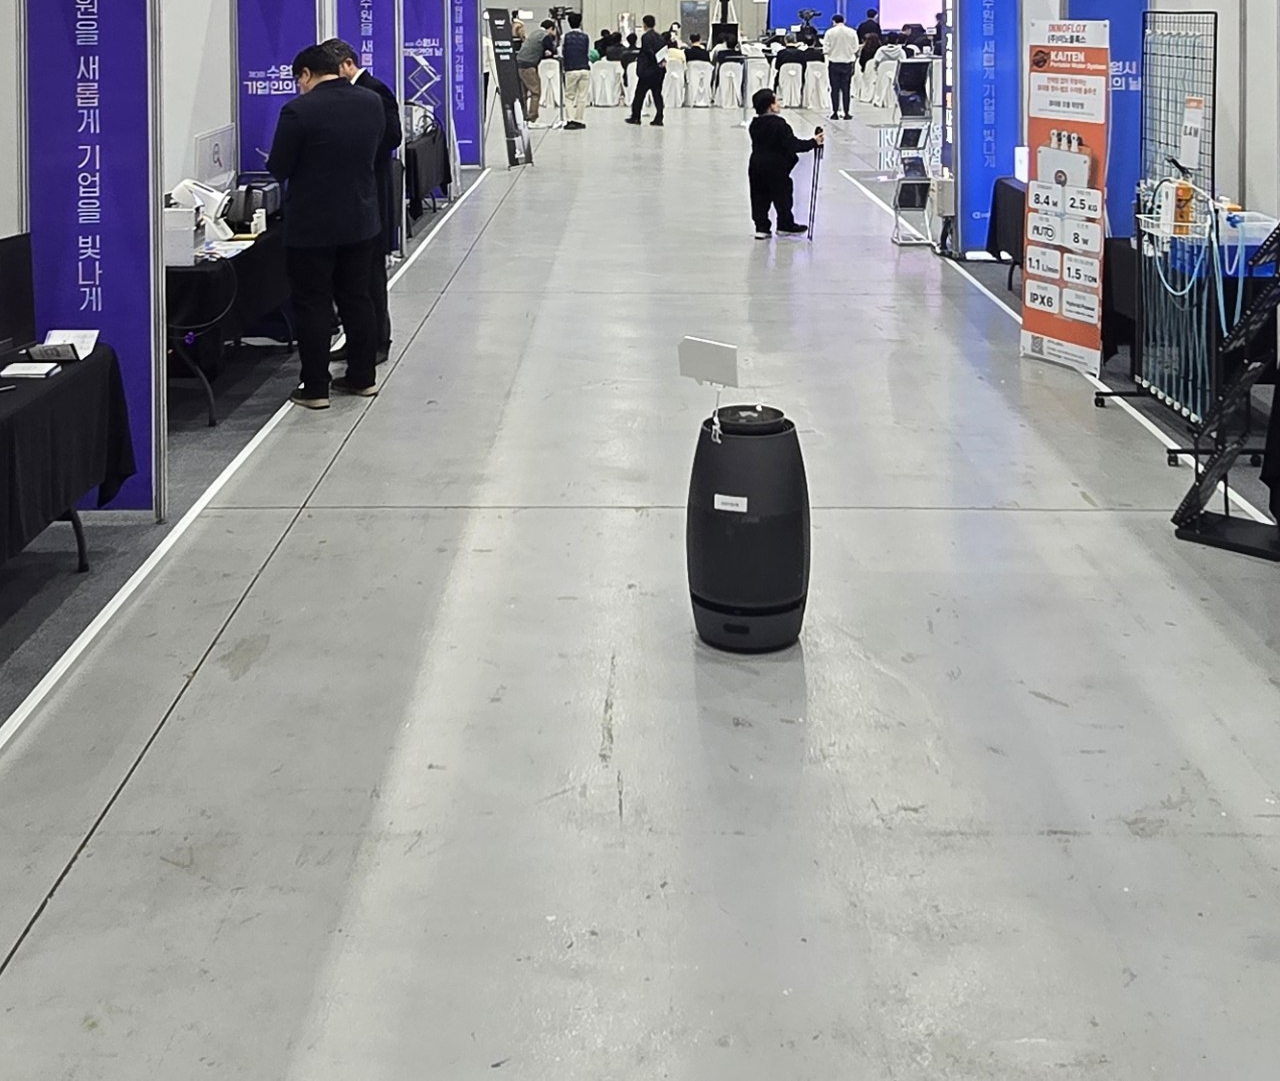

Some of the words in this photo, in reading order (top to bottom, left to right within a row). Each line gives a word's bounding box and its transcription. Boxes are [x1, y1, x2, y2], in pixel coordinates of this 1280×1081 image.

[1050, 51, 1086, 62] KAITEN
[76, 56, 101, 135] 새롭게
[243, 81, 297, 95] 기업인의
[77, 145, 102, 225] 기업을
[1034, 193, 1050, 206] 8.4
[1069, 197, 1086, 210] 2.5
[1088, 204, 1098, 212] KG
[1073, 232, 1080, 244] 8
[1028, 257, 1040, 270] 1.1
[77, 235, 103, 313] 빛나게
[1067, 266, 1081, 280] 1.5
[1083, 275, 1098, 284] TON
[1030, 292, 1054, 308] IPX6
